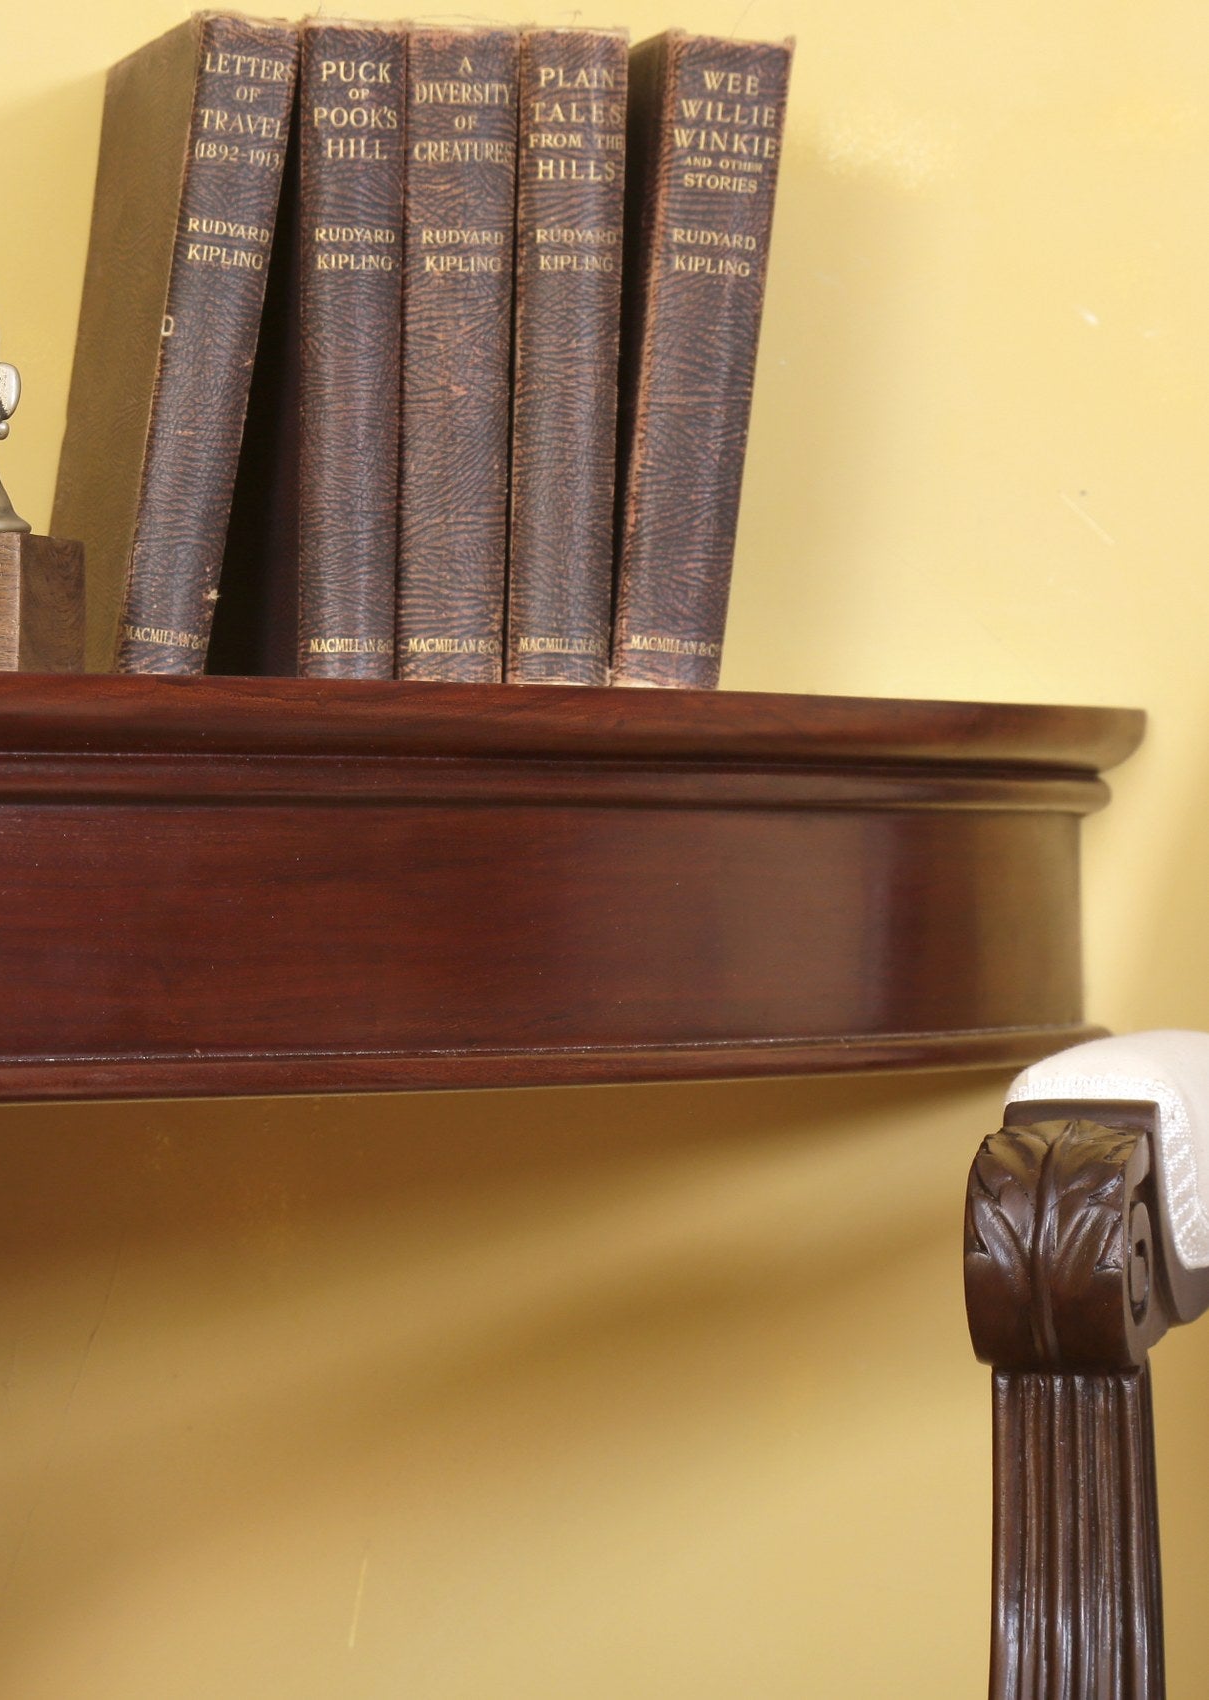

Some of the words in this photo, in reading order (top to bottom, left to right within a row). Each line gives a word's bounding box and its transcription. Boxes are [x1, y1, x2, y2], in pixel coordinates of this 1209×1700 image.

[204, 52, 295, 82] LETTERS
[321, 60, 392, 83] PUCK
[458, 56, 473, 75] A
[539, 67, 616, 89] PLAIN
[703, 70, 760, 96] WEE
[236, 85, 261, 104] OF
[348, 87, 370, 100] OF
[414, 81, 512, 105] DIVERSITY
[312, 105, 398, 129] POOK'S
[454, 114, 478, 131] OF
[531, 101, 623, 124] TALES
[681, 99, 777, 129] WILLIE
[200, 107, 287, 141] TRAVEL
[326, 138, 388, 160] HILL
[413, 140, 515, 163] CREATURES
[529, 133, 583, 149] FROM
[594, 134, 624, 151] THE
[673, 128, 776, 159] WINKIE
[537, 159, 616, 182] HILLS
[684, 156, 712, 168] AND
[719, 158, 764, 175] OTHER
[683, 173, 759, 194] STORIES
[187, 217, 270, 244] RUDYARD
[315, 227, 395, 244] RUDYARD
[422, 228, 504, 245] RUDYARD
[535, 228, 617, 245] RUDYARD
[672, 227, 757, 251] RUDYARD
[187, 243, 264, 270] KIPLING
[317, 253, 392, 271] KIPLING
[425, 255, 502, 272] KIPLING
[540, 254, 614, 273] KIPLING
[674, 254, 751, 278] KIPLING
[309, 638, 375, 653] MACMILLAN
[407, 638, 476, 653] MACMILLAN
[518, 637, 589, 653] MACMILLAN
[631, 634, 698, 655] MACMILLAN
